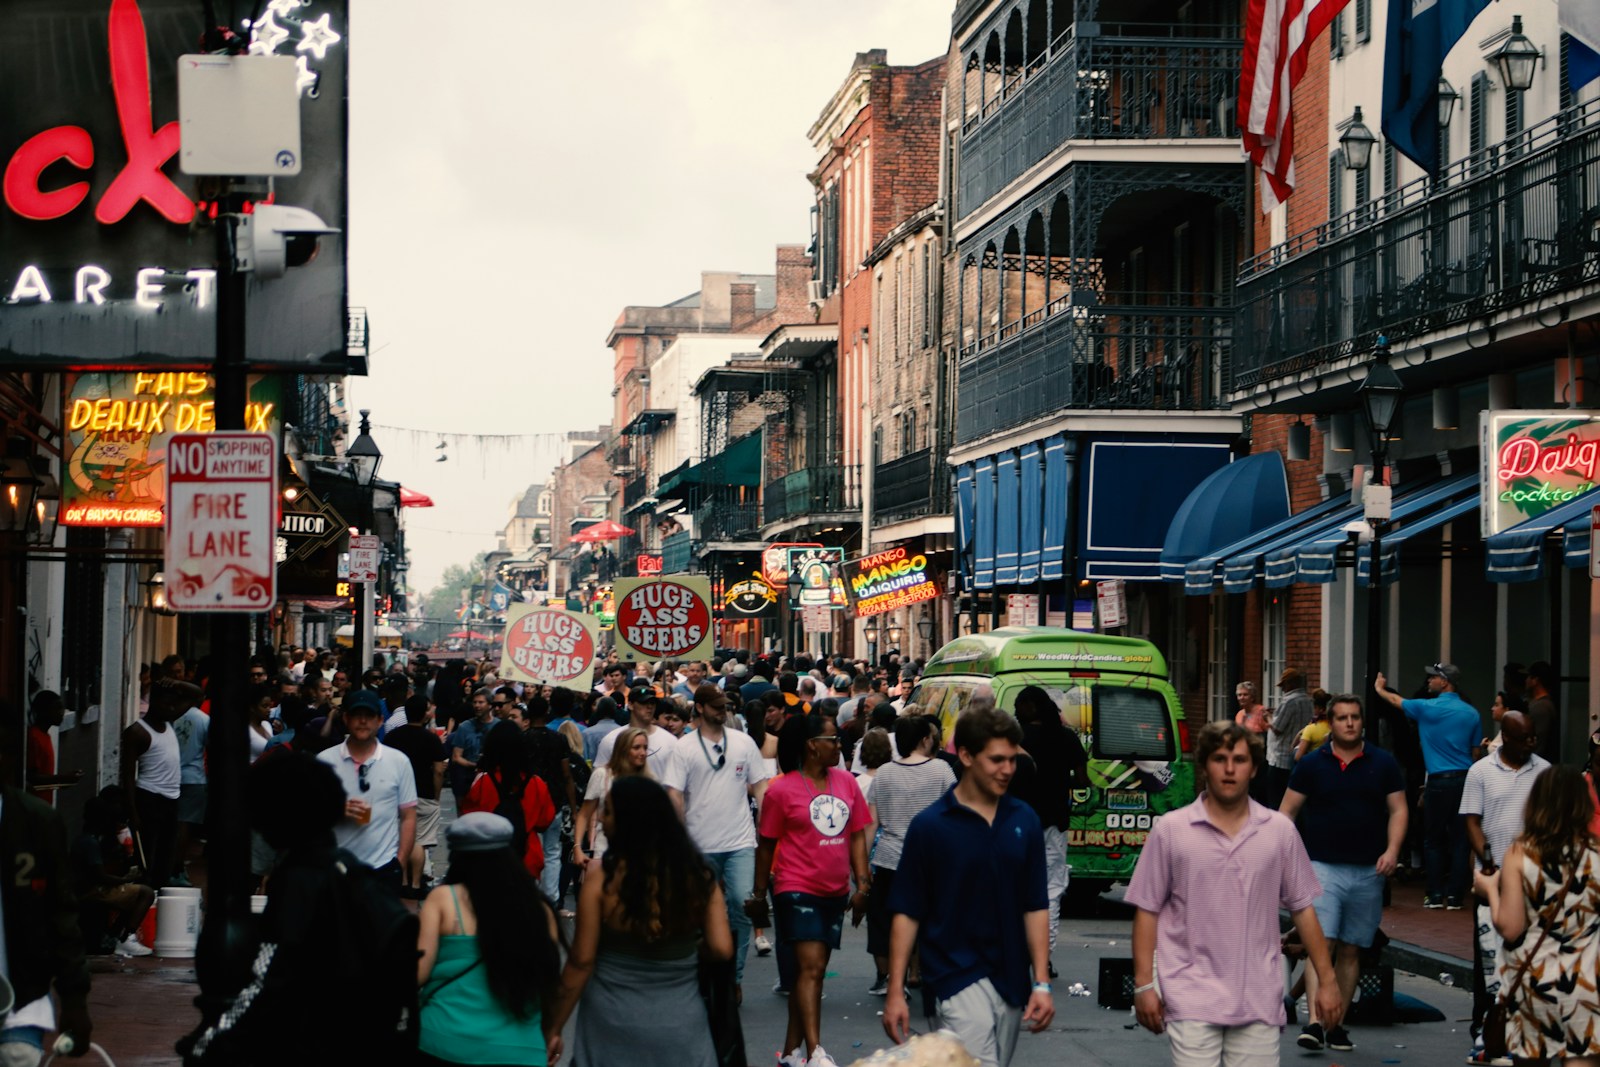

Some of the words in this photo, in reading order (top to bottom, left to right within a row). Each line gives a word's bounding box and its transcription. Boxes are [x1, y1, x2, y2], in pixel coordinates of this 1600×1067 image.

[8, 264, 217, 309] ARET
[69, 398, 171, 433] DEAUX
[174, 400, 273, 434] DEX
[171, 442, 205, 476] NO
[208, 441, 270, 456] STOPPING
[211, 460, 265, 474] ANYTIME
[193, 492, 247, 520] FIRE
[188, 531, 252, 558] LANE
[861, 548, 906, 570] MANGO
[851, 554, 927, 593] MANGO
[858, 572, 927, 598] DAIQUIRIS
[631, 584, 695, 610] HUGE
[908, 581, 935, 594] BEER
[636, 608, 689, 626] ASS
[859, 602, 881, 617] PIZZA
[523, 613, 584, 641] HUGE
[627, 624, 701, 651] BEERS
[524, 633, 576, 655] ASS
[1013, 652, 1152, 663] www.WeedWorldCandies.global
[513, 647, 584, 677] BEERS
[15, 853, 36, 887] 2
